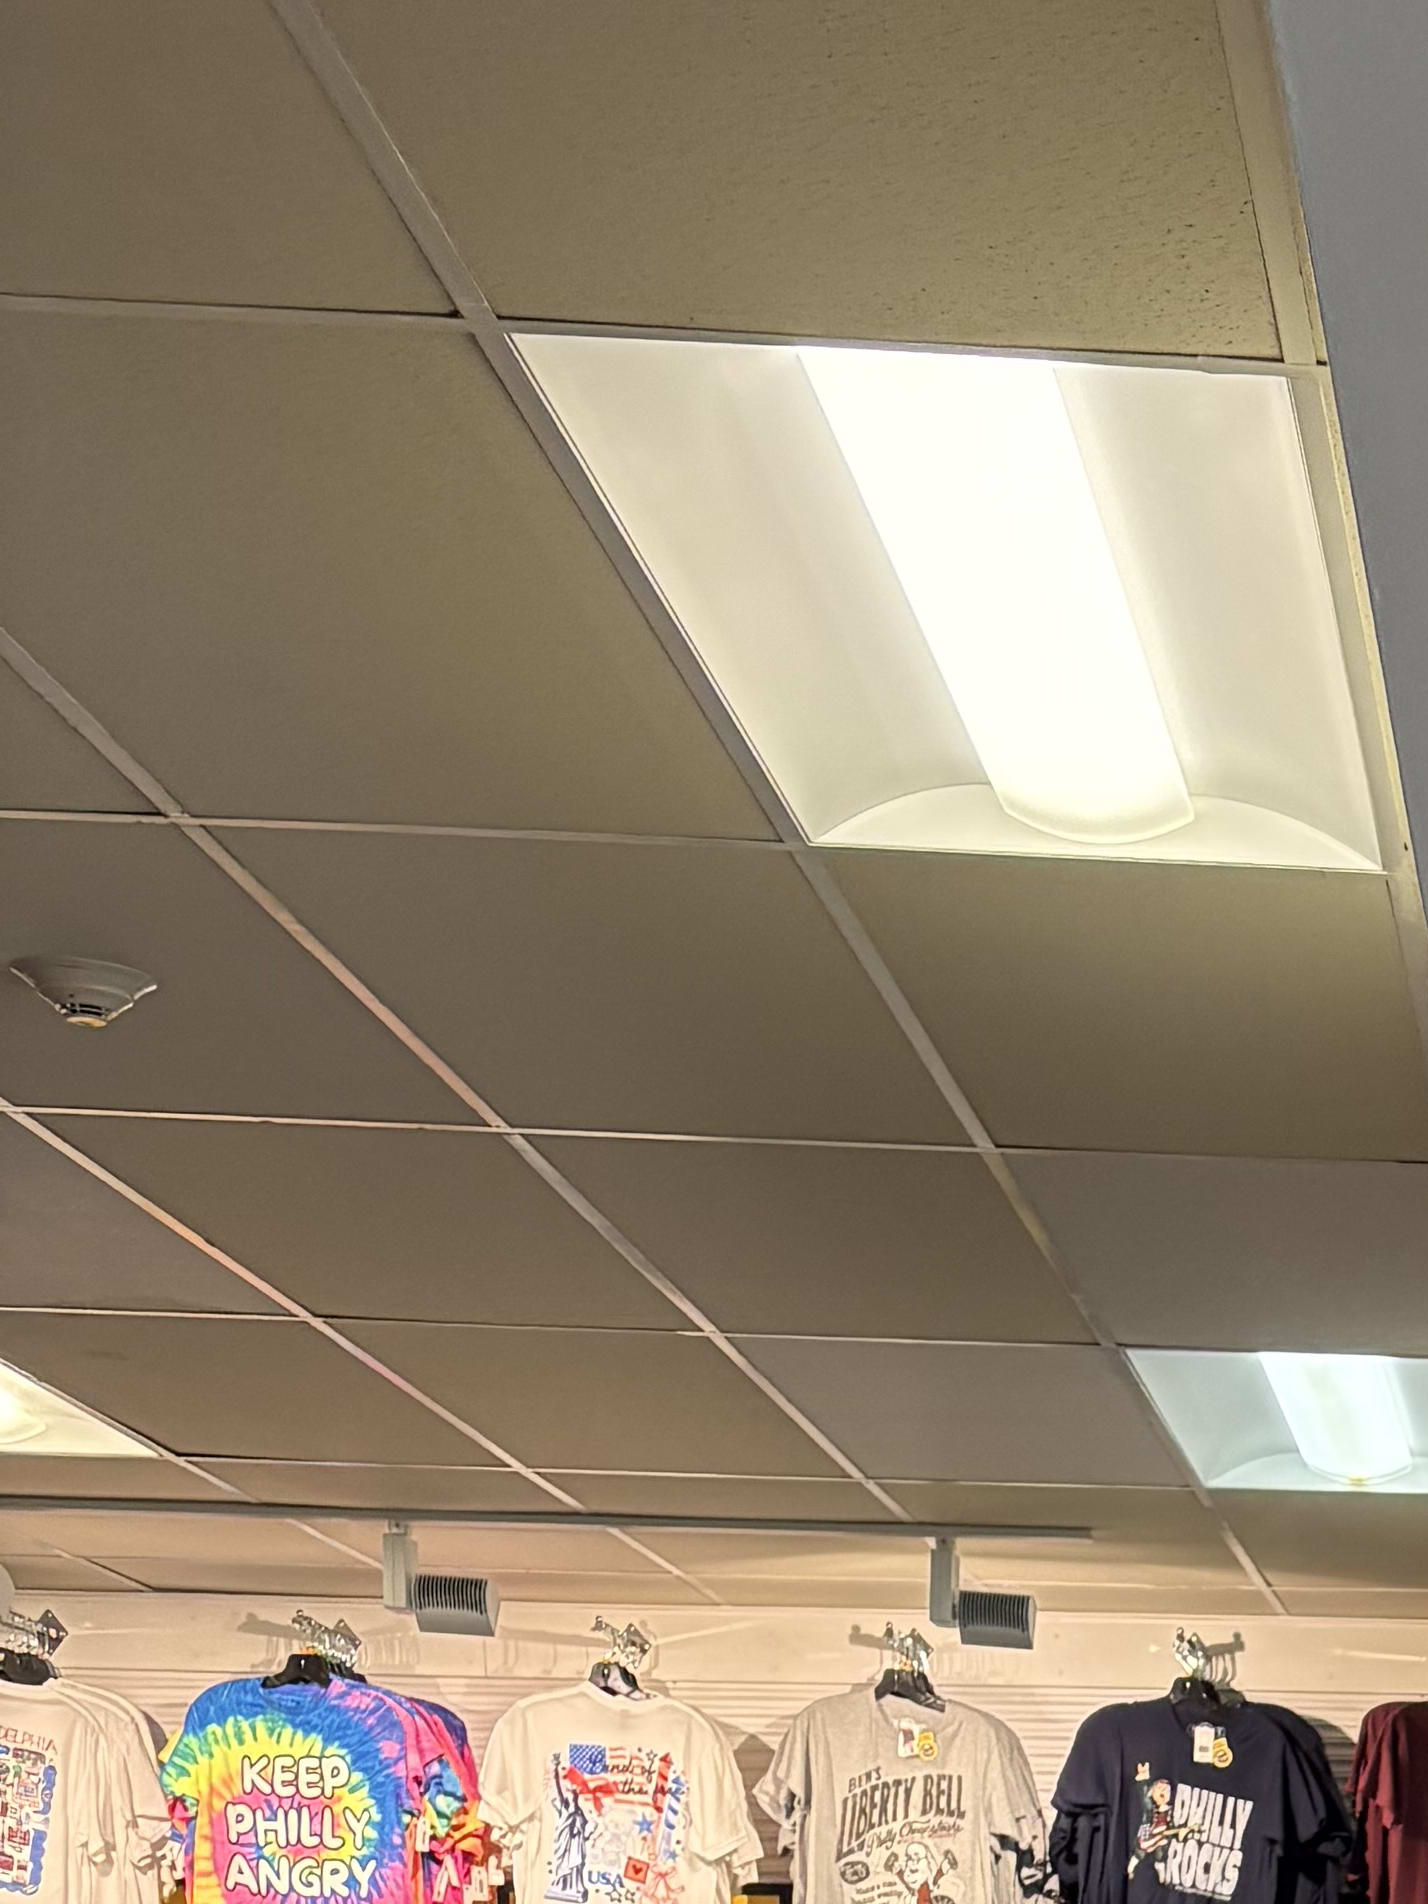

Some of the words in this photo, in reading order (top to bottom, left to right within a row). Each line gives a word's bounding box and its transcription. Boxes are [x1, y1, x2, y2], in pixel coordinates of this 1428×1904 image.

[241, 1754, 350, 1799] KEEP
[848, 1766, 882, 1793] BEN'S
[225, 1801, 372, 1849] PHILLY
[836, 1776, 916, 1863] LIBERTY
[920, 1773, 966, 1820] BELL
[1173, 1783, 1254, 1850] PHILLY
[225, 1852, 377, 1898] ANGRY
[588, 1870, 625, 1889] USA
[1165, 1838, 1244, 1896] ROCKS
